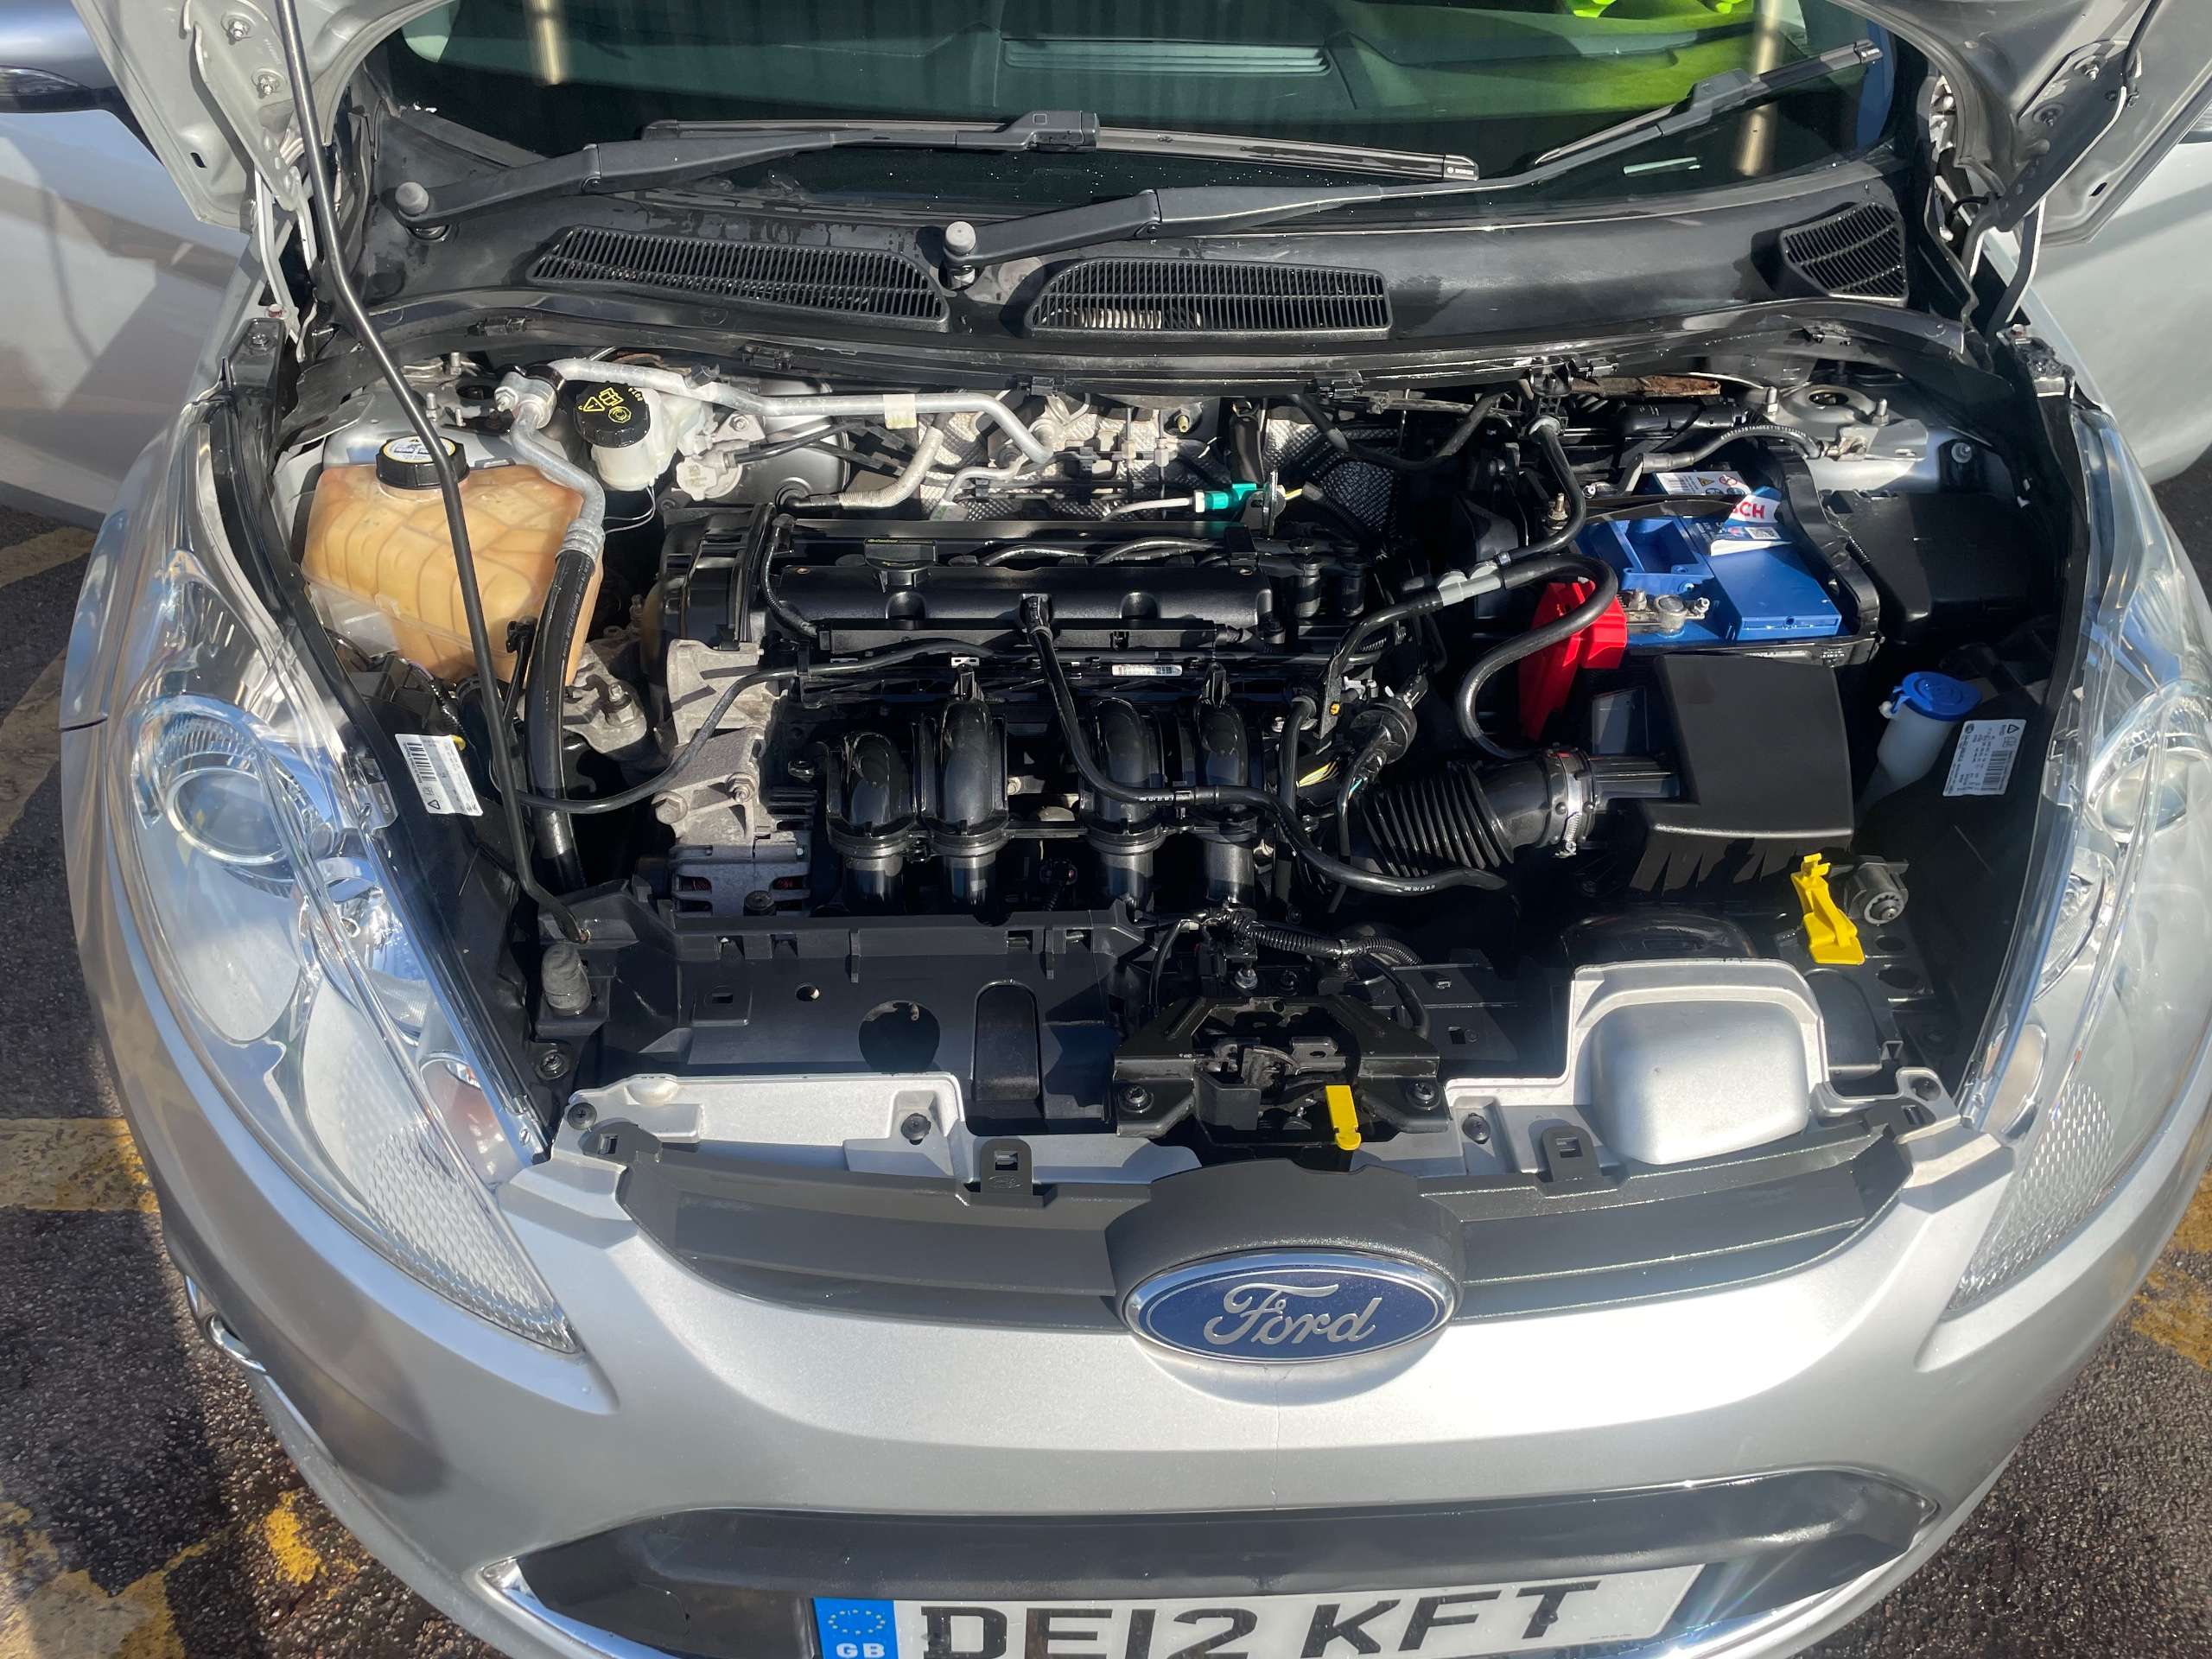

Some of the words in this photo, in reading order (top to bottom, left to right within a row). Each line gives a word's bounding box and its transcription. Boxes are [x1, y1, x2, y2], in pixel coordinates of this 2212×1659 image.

[1204, 1282, 1382, 1344] Ford
[836, 1643, 885, 1658] GB
[921, 1606, 1258, 1659] DE12
[1300, 1580, 1602, 1659] KFT
